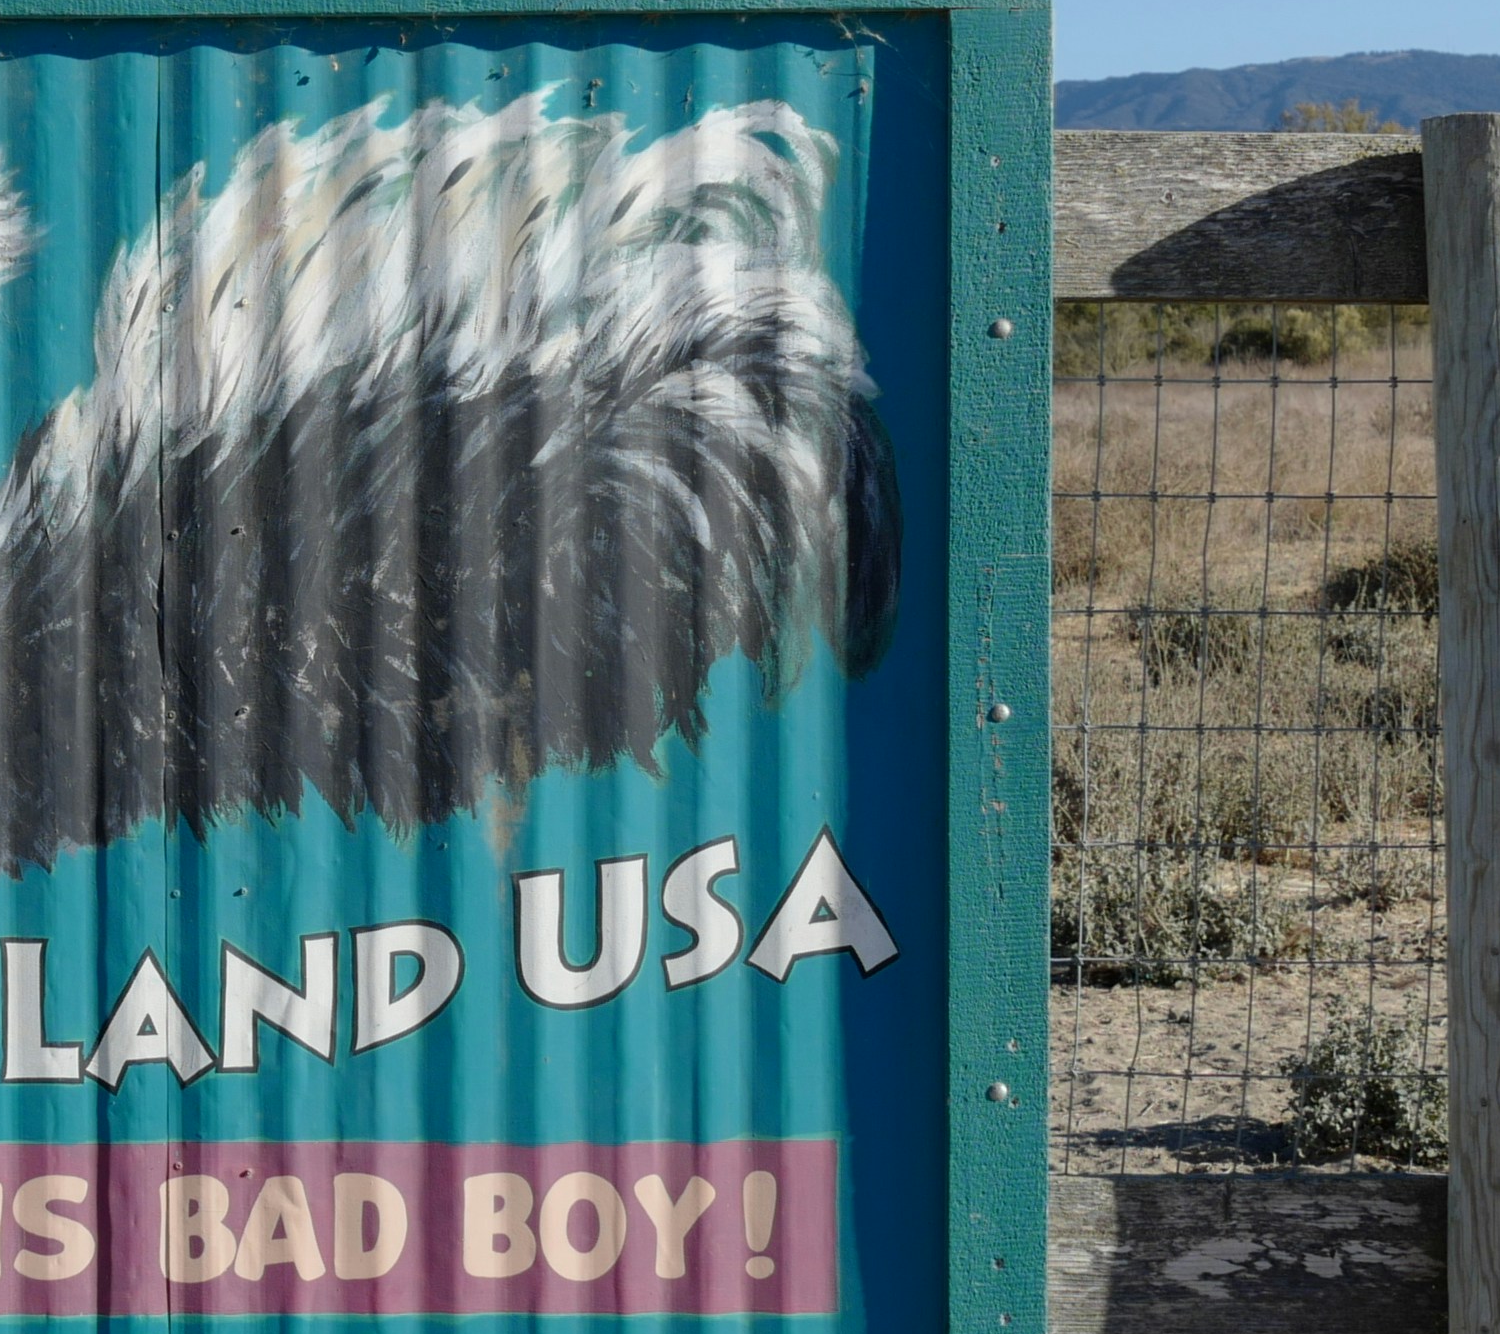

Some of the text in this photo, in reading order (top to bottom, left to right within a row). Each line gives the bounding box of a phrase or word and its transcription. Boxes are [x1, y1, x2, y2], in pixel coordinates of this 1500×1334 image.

[513, 824, 901, 1011] USA
[159, 1173, 408, 1283] BAD
[462, 1171, 778, 1281] BOY!
